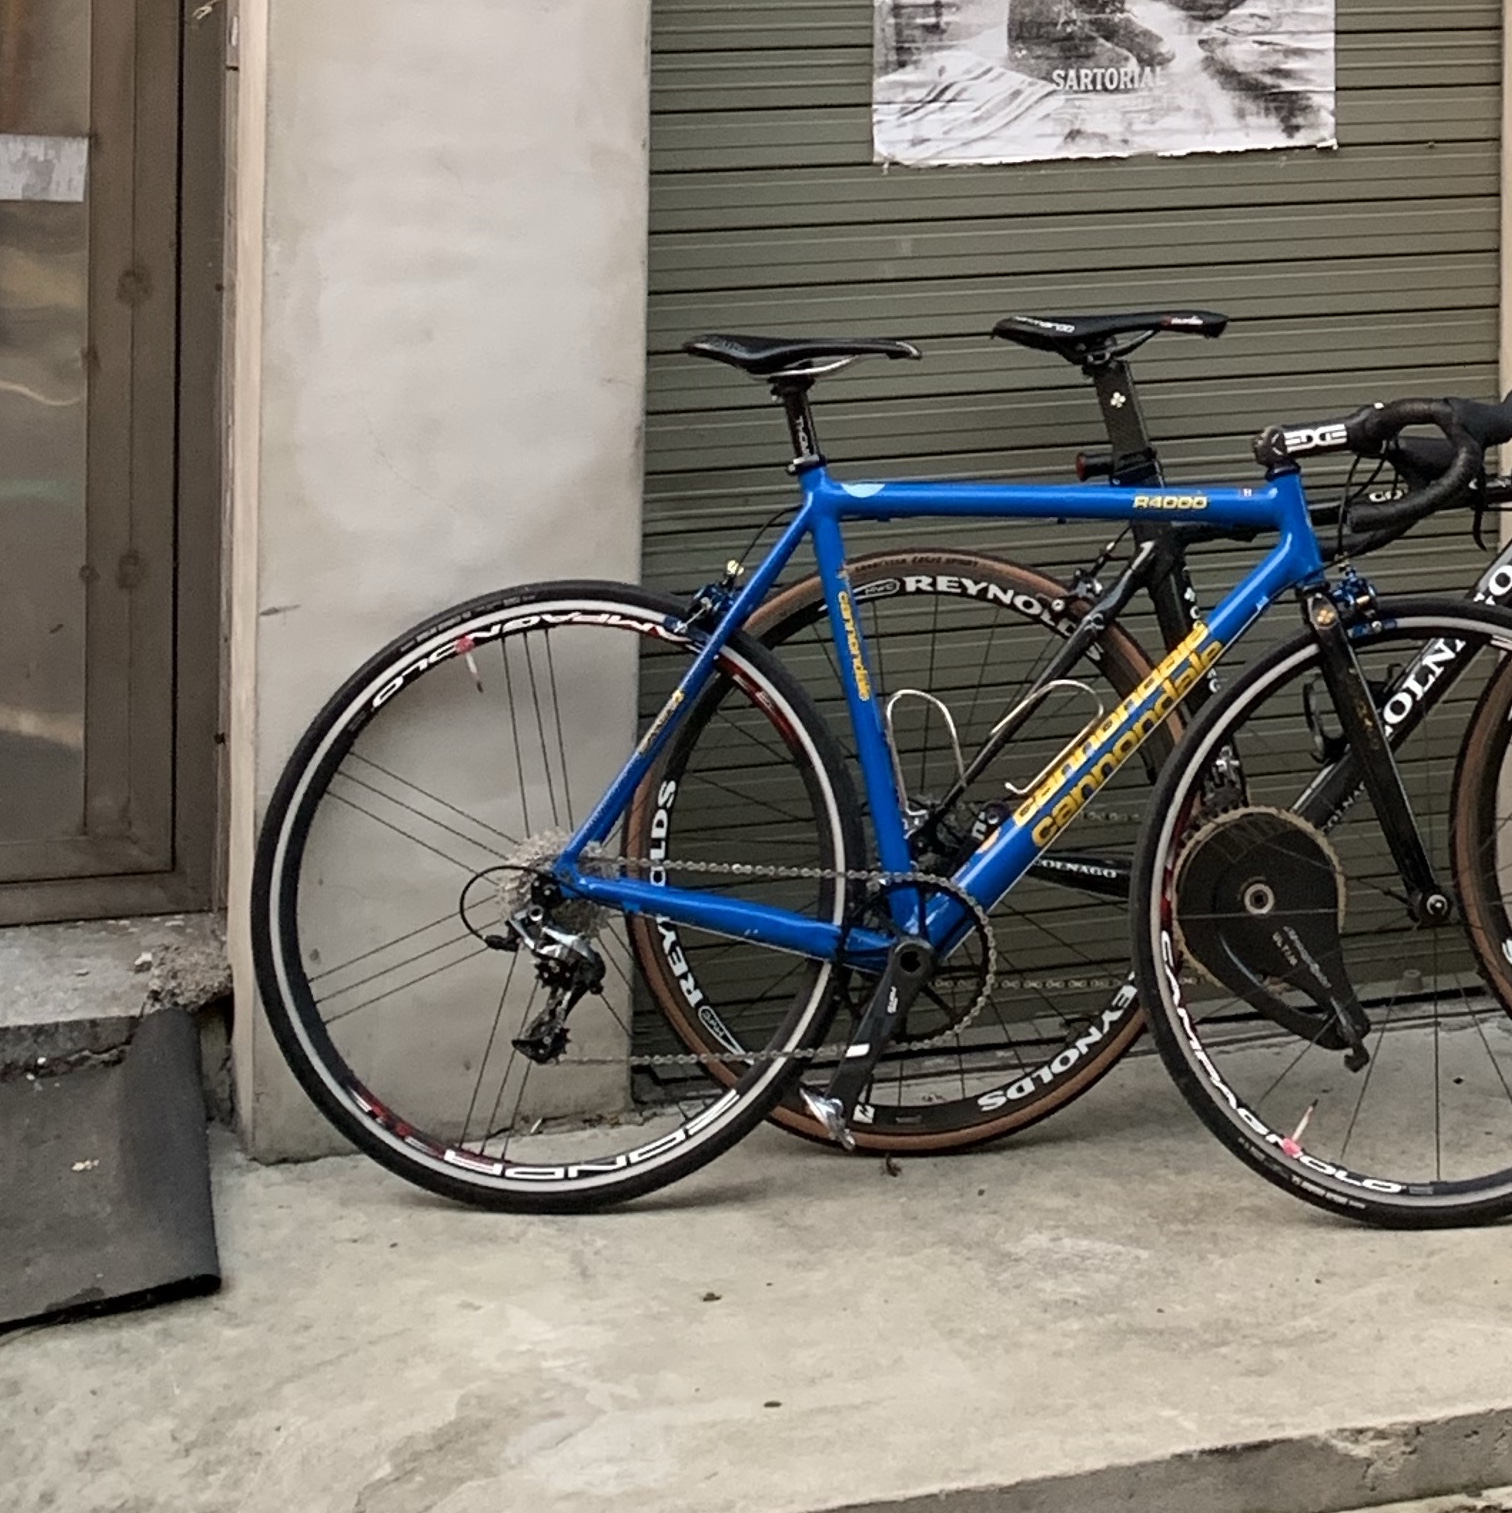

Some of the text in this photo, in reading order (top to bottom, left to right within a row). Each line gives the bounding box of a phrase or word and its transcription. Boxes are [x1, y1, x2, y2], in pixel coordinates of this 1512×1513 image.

[1051, 66, 1167, 92] SARTORIAL
[1132, 495, 1208, 510] R4000
[1031, 641, 1223, 848] cannondale
[649, 780, 704, 1008] REYOLDS
[977, 971, 1139, 1112] EYNOLDS
